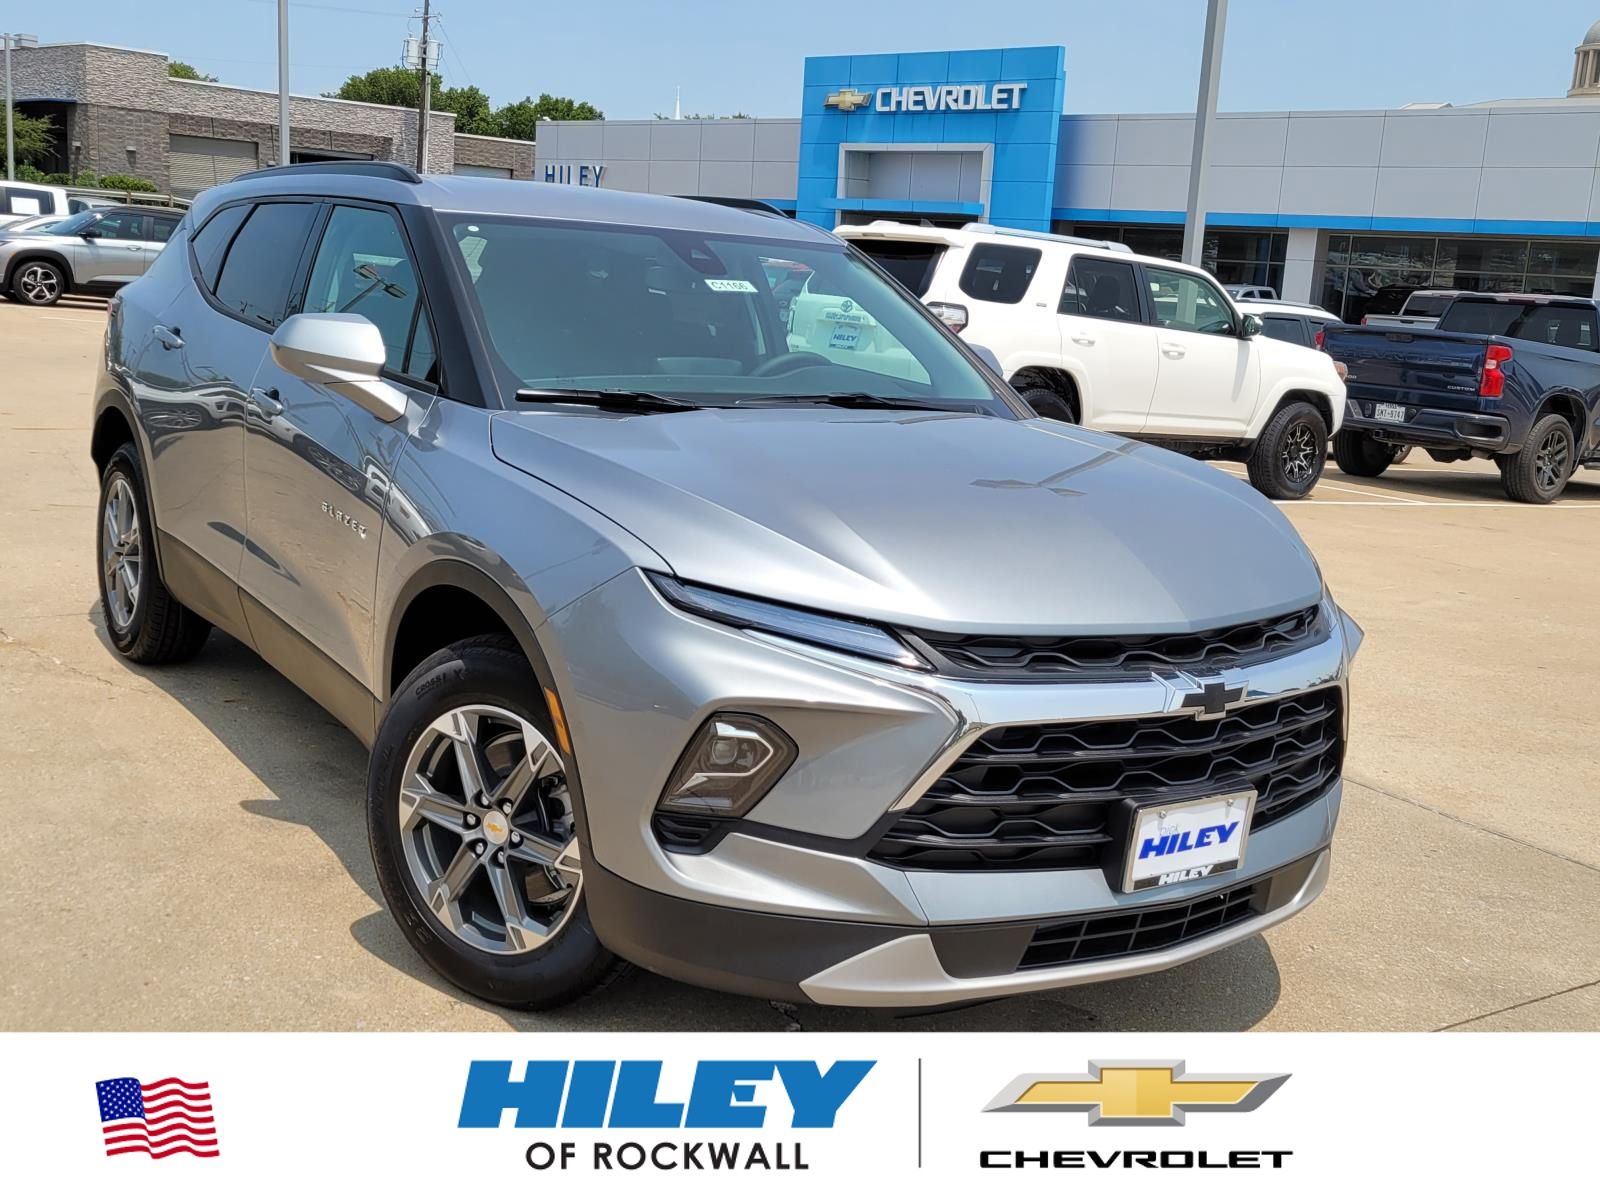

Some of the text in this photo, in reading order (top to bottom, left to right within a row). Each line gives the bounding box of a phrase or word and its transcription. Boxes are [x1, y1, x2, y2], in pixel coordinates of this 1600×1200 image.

[876, 82, 1028, 112] CHEVROLET
[832, 333, 858, 342] HILEY
[1446, 384, 1476, 392] CUSTOM
[321, 501, 367, 539] BLAZER
[1138, 820, 1240, 860] HILEY
[1158, 864, 1214, 886] HILEY
